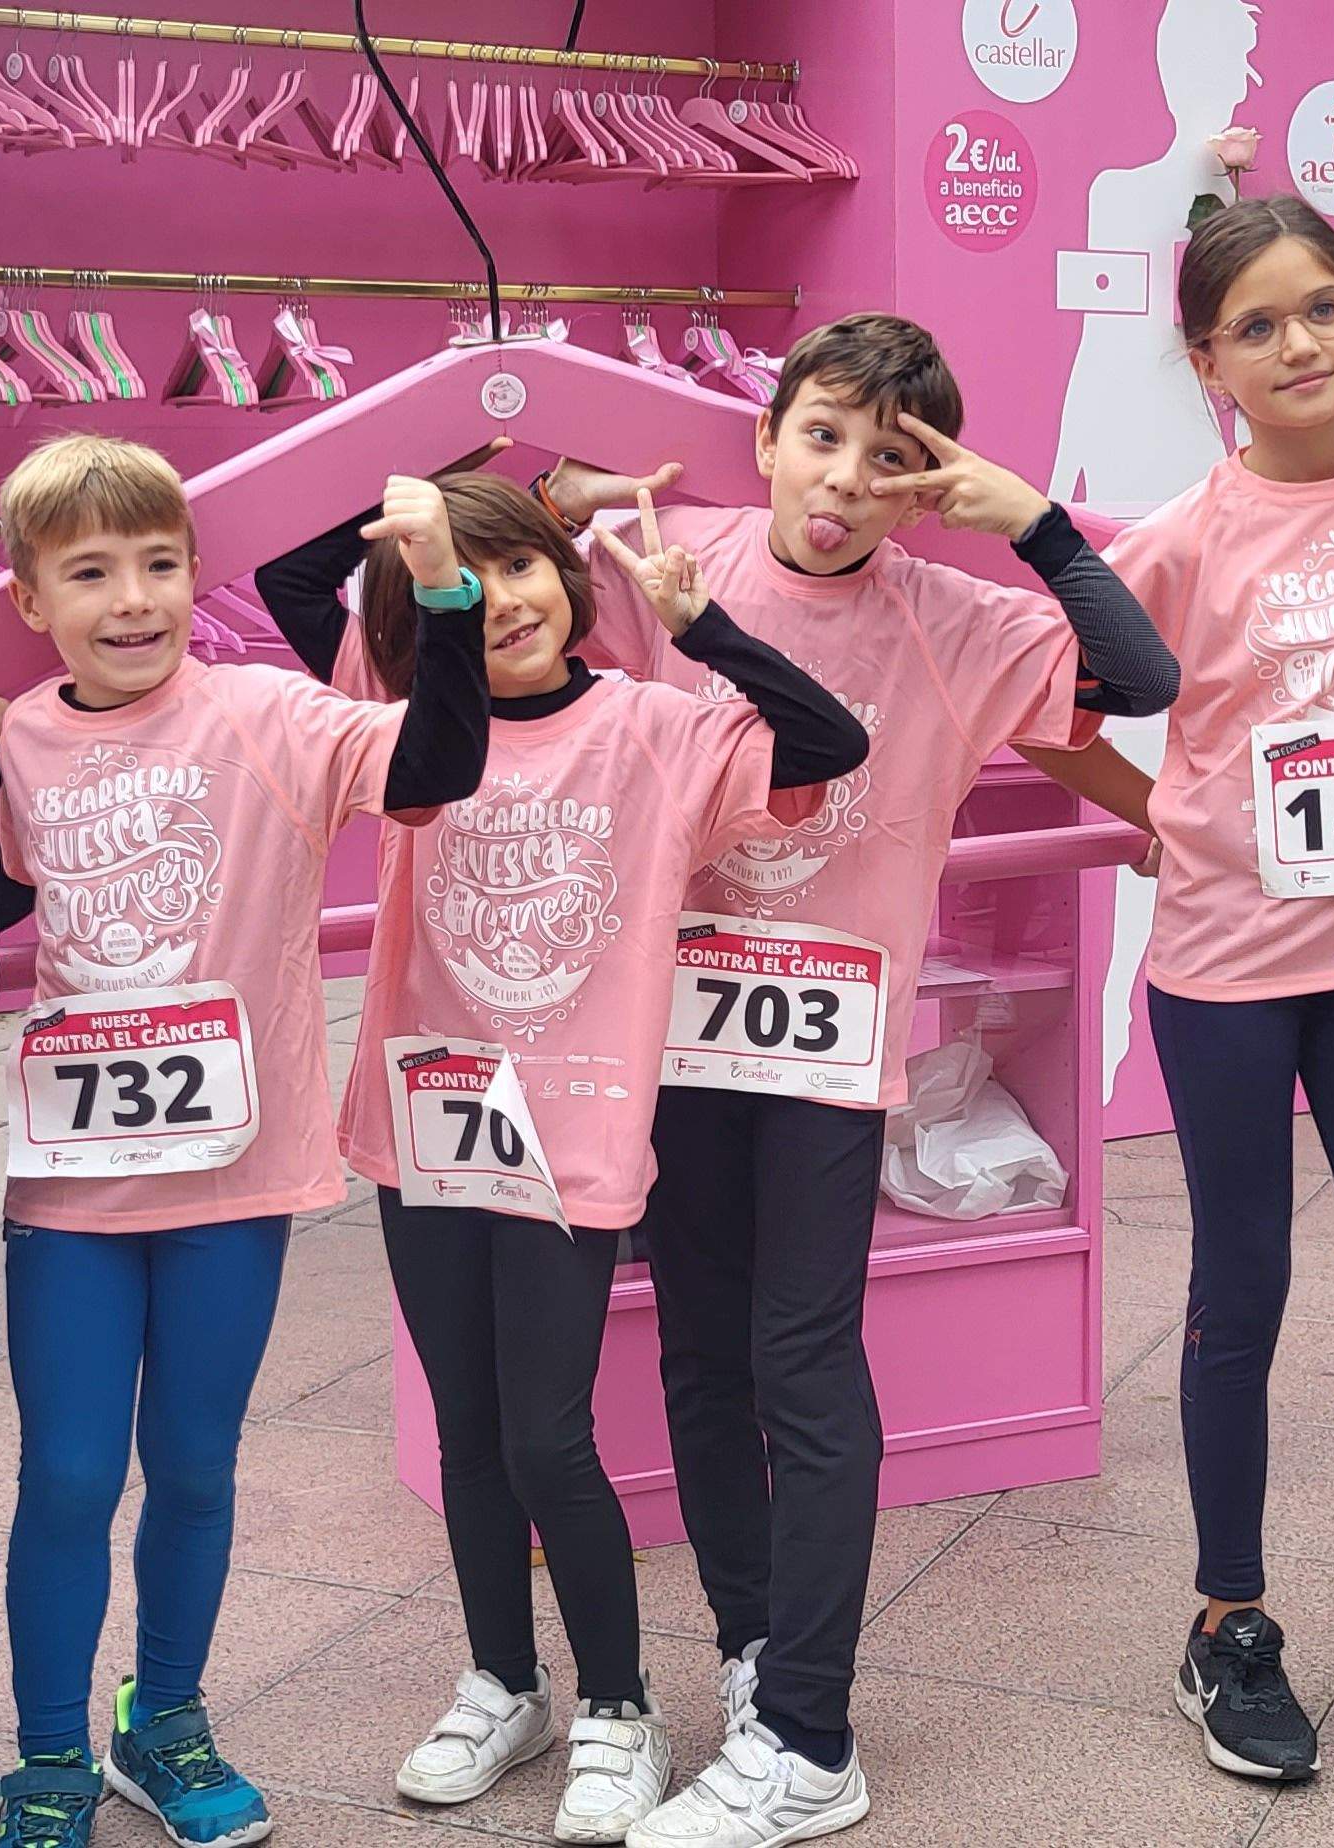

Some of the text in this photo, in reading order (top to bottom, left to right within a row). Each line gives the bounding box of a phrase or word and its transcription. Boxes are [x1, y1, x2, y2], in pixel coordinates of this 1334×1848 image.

[975, 37, 1066, 68] castellar
[940, 177, 1022, 198] a beneficio
[945, 203, 1017, 226] aecc
[65, 765, 187, 819] CARRERA
[476, 799, 599, 834] CARRERA
[680, 927, 713, 943] DICIÓN
[744, 939, 802, 957] HUESCA
[677, 948, 869, 980] CONTRA EL CÁNCER
[91, 1012, 151, 1030] HUESCA
[697, 977, 840, 1052] 703
[32, 1020, 229, 1053] CONTRA EL CÁNCER
[418, 1072, 490, 1091] CONTRA
[477, 1060, 499, 1073] HUE
[55, 1055, 213, 1130] 732
[443, 1100, 525, 1167] 70
